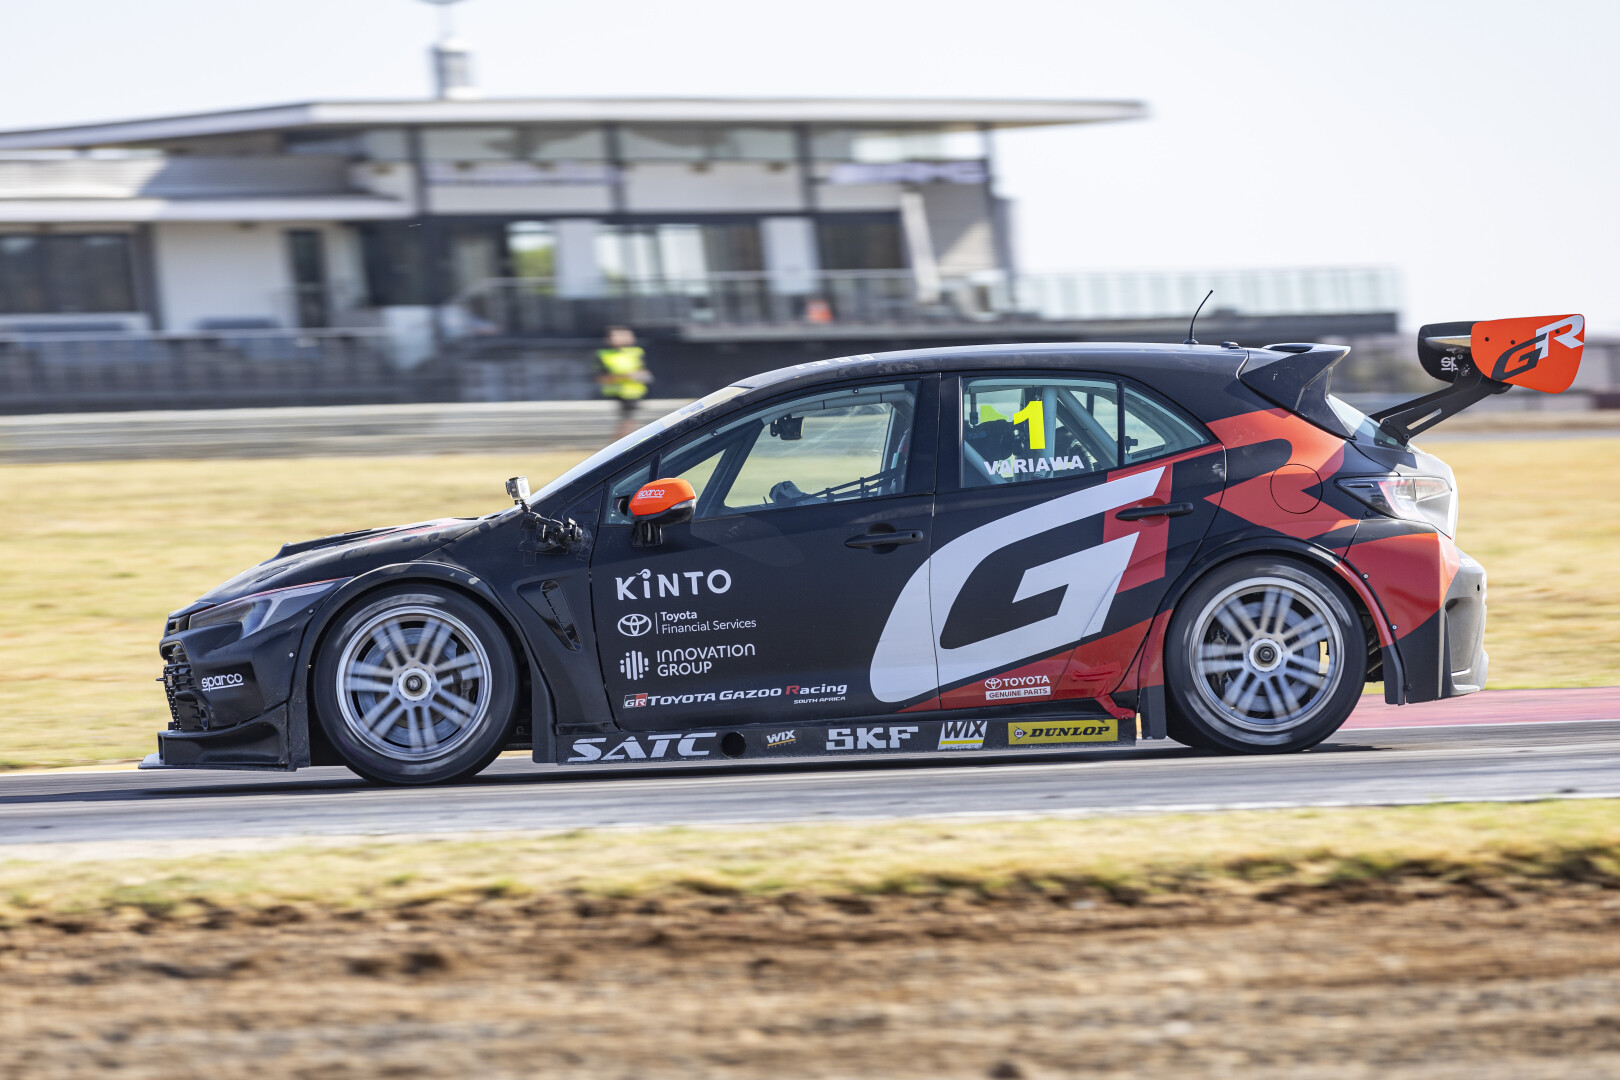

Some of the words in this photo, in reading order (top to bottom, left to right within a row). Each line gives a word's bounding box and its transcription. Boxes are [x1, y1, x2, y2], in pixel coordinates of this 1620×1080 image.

[1013, 400, 1046, 450] 1
[983, 455, 1085, 475] VARIAWA
[637, 489, 665, 499] sparco
[661, 610, 698, 623] Toyota
[661, 621, 710, 635] Financial
[713, 618, 757, 631] Services
[657, 661, 712, 677] GROUP
[201, 673, 243, 691] sparco
[1002, 675, 1050, 687] TOYOTA
[624, 698, 647, 708] GR
[647, 692, 716, 706] TOYOTA
[719, 687, 782, 701] GAZOO
[785, 683, 848, 696] Racing
[989, 690, 1022, 699] GENUINE
[1023, 688, 1048, 696] PARTS
[766, 729, 796, 744] WIX
[942, 720, 986, 739] WIX
[1029, 726, 1111, 738] DUNLOP
[826, 726, 919, 751] SKF
[567, 732, 717, 763] SATC
